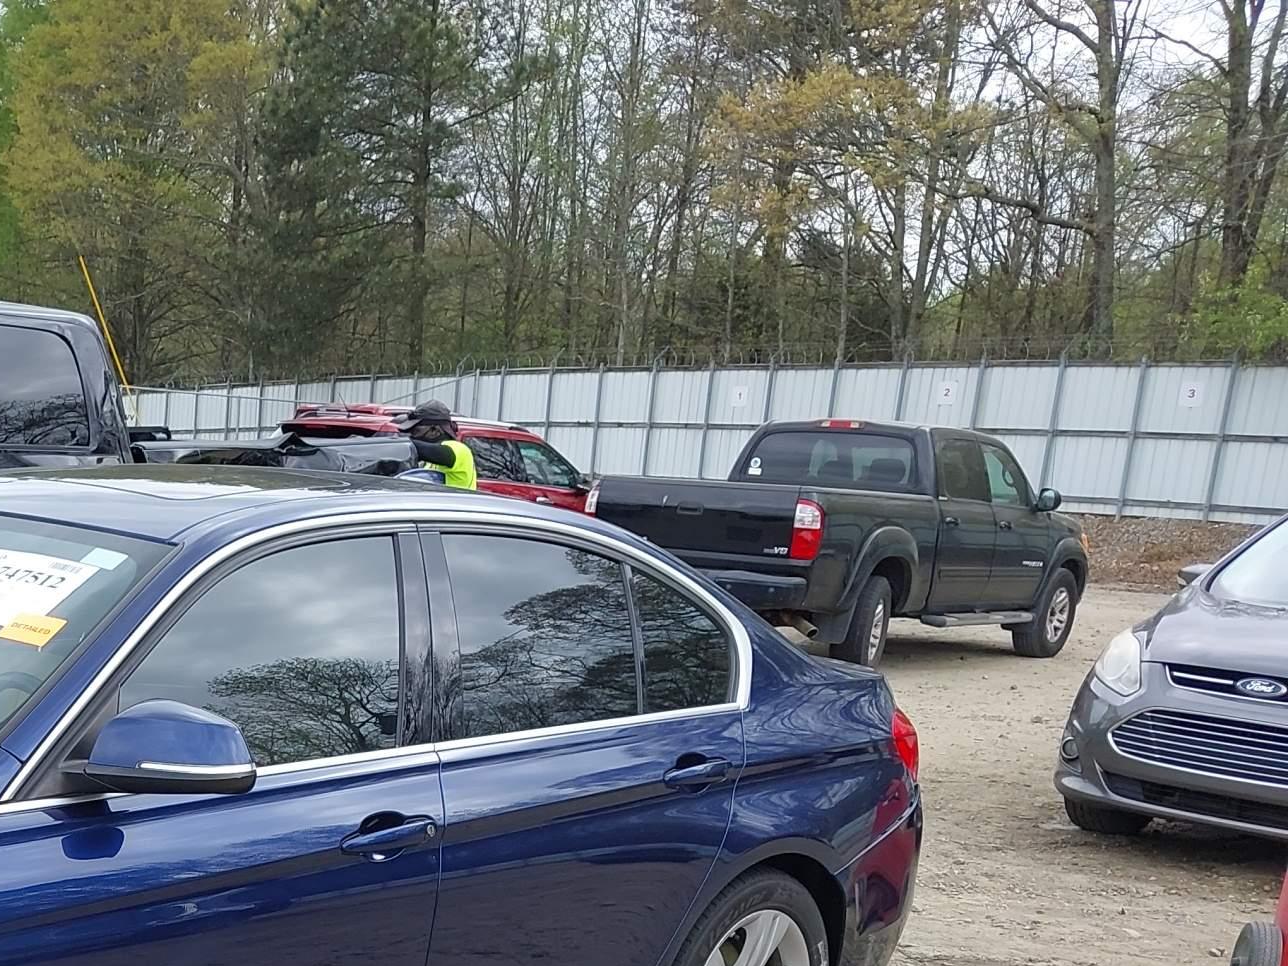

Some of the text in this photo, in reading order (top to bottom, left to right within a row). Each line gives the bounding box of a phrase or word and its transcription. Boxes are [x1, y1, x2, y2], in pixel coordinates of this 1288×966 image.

[943, 388, 951, 397] 2
[1187, 388, 1196, 398] 3
[11, 622, 51, 636] DETAILED
